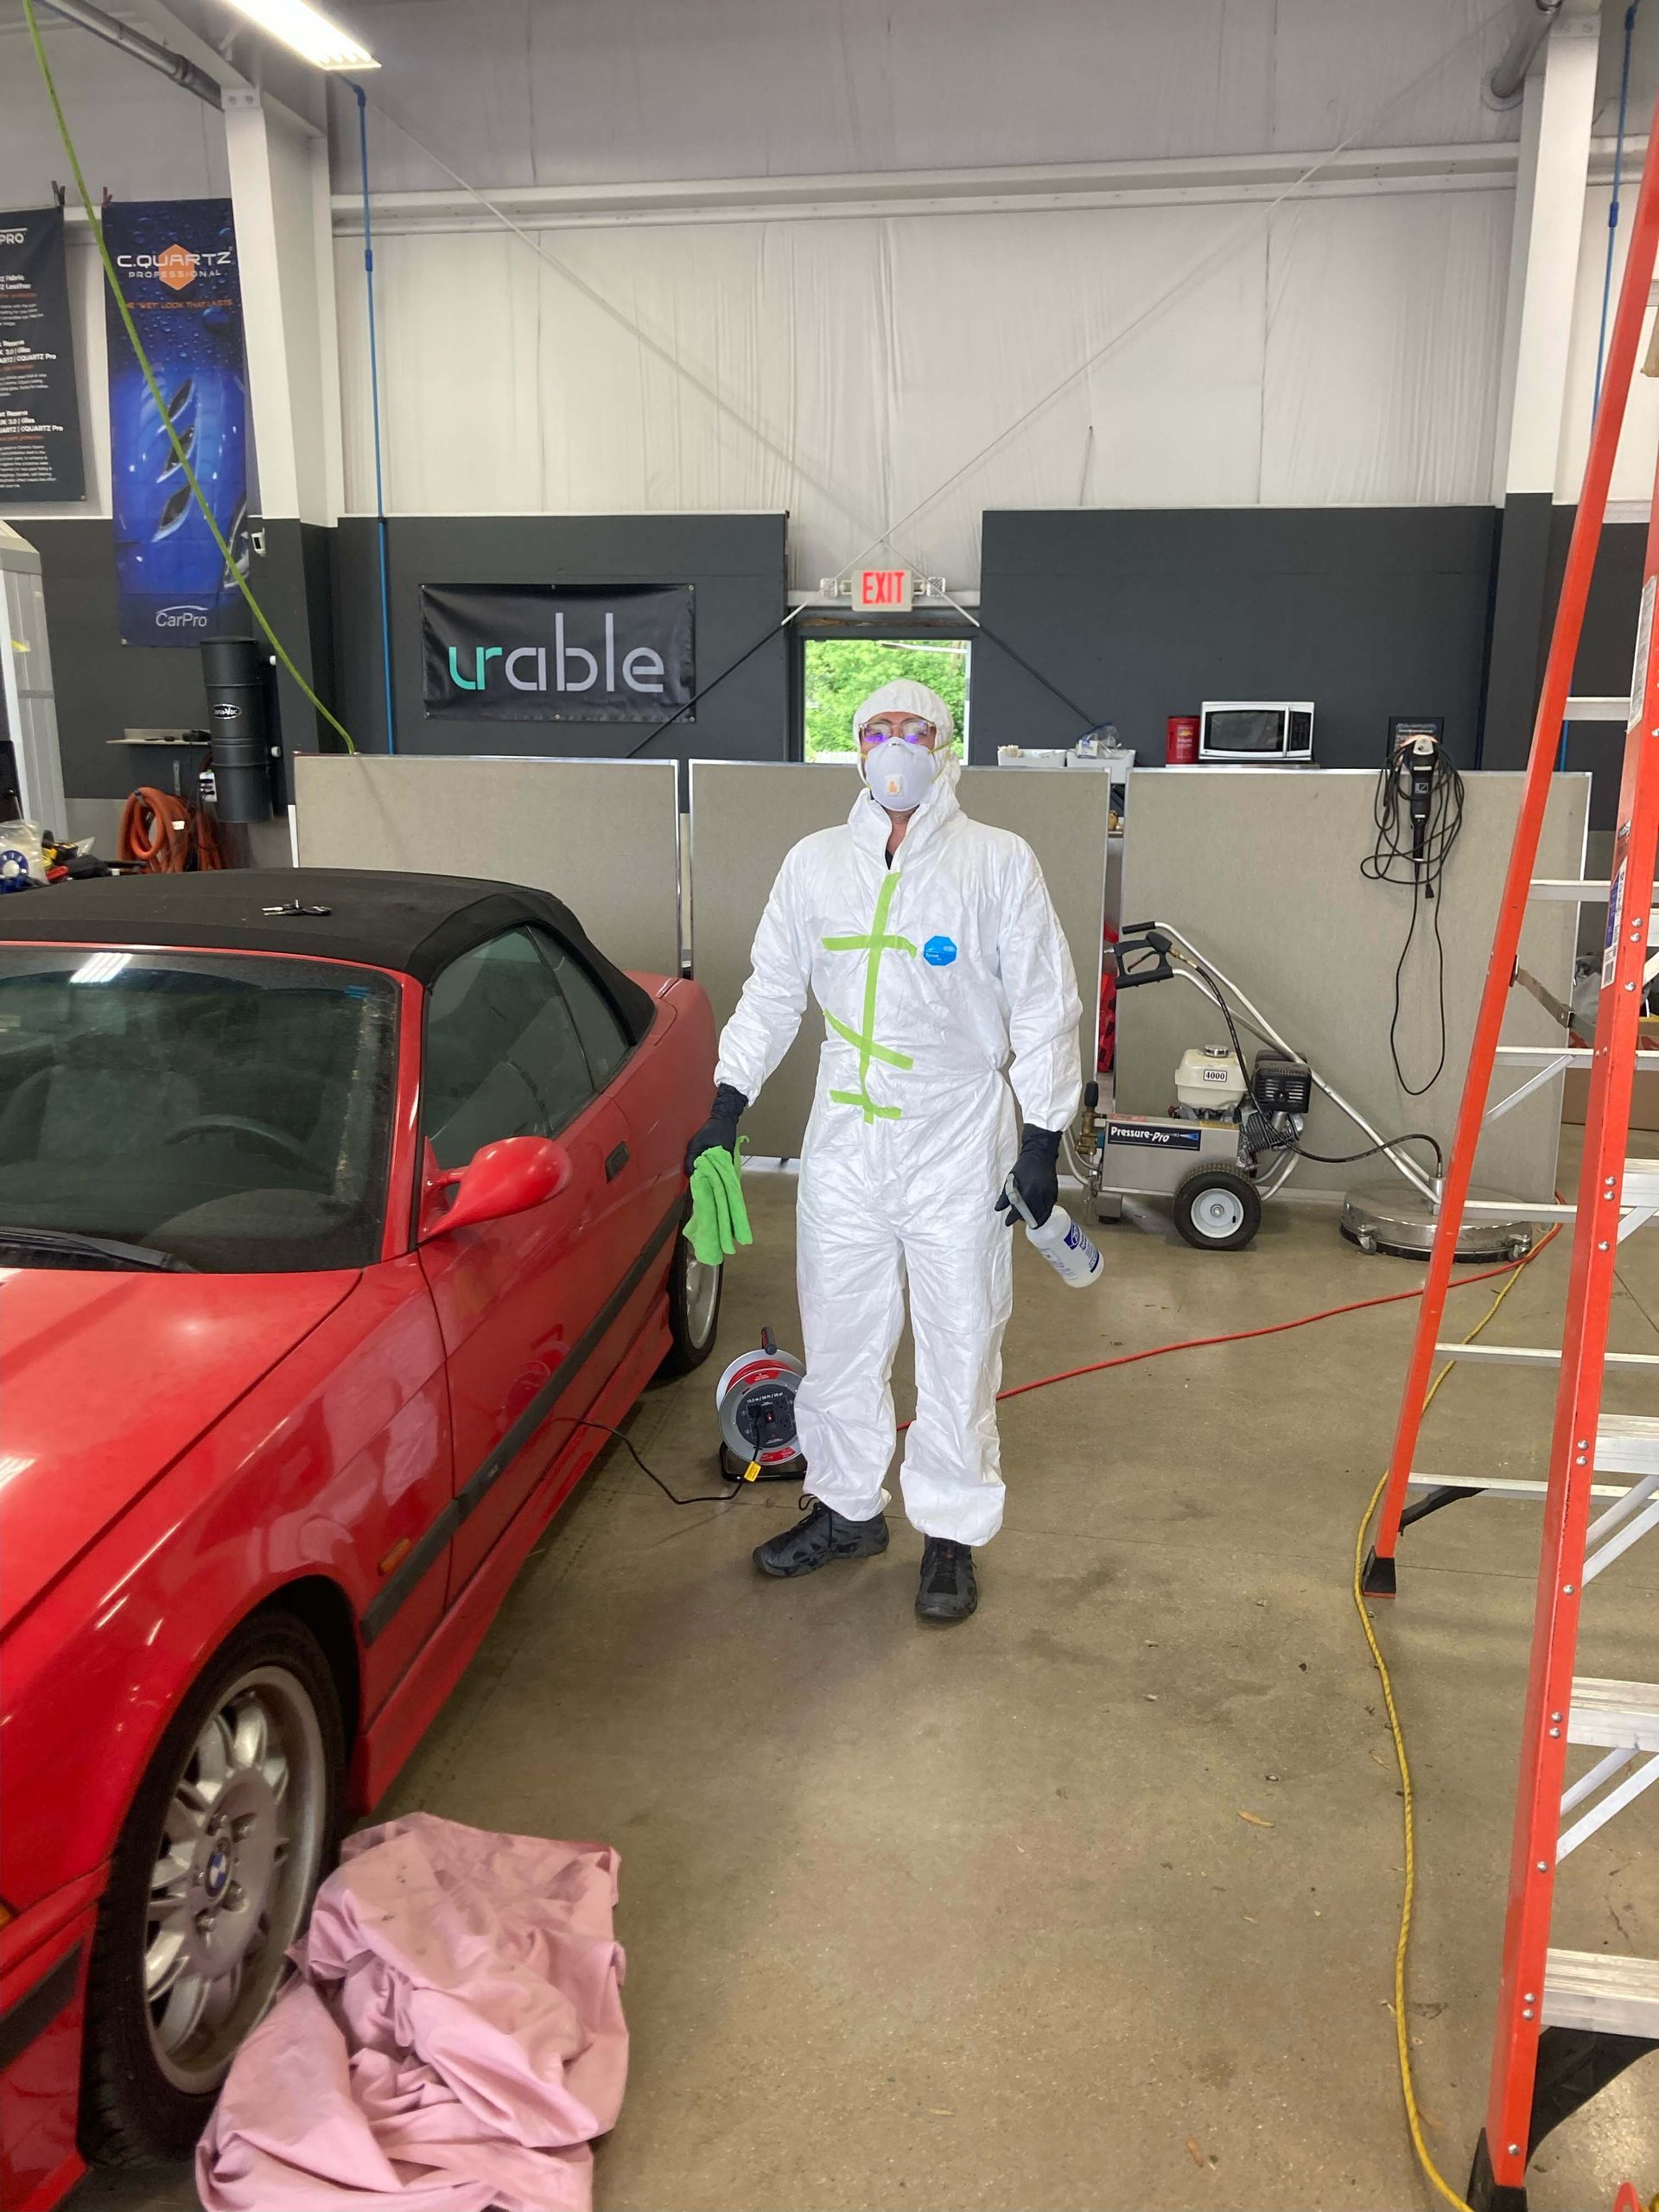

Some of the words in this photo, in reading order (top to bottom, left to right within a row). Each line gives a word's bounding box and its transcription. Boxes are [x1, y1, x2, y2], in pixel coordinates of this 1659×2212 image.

[129, 270, 221, 278] PROFESSIONAL
[862, 571, 905, 605] EXIT
[156, 612, 207, 627] CarPro
[448, 612, 664, 692] urable
[1205, 1071, 1225, 1080] 4000
[1110, 1126, 1170, 1142] Pressure-Pro
